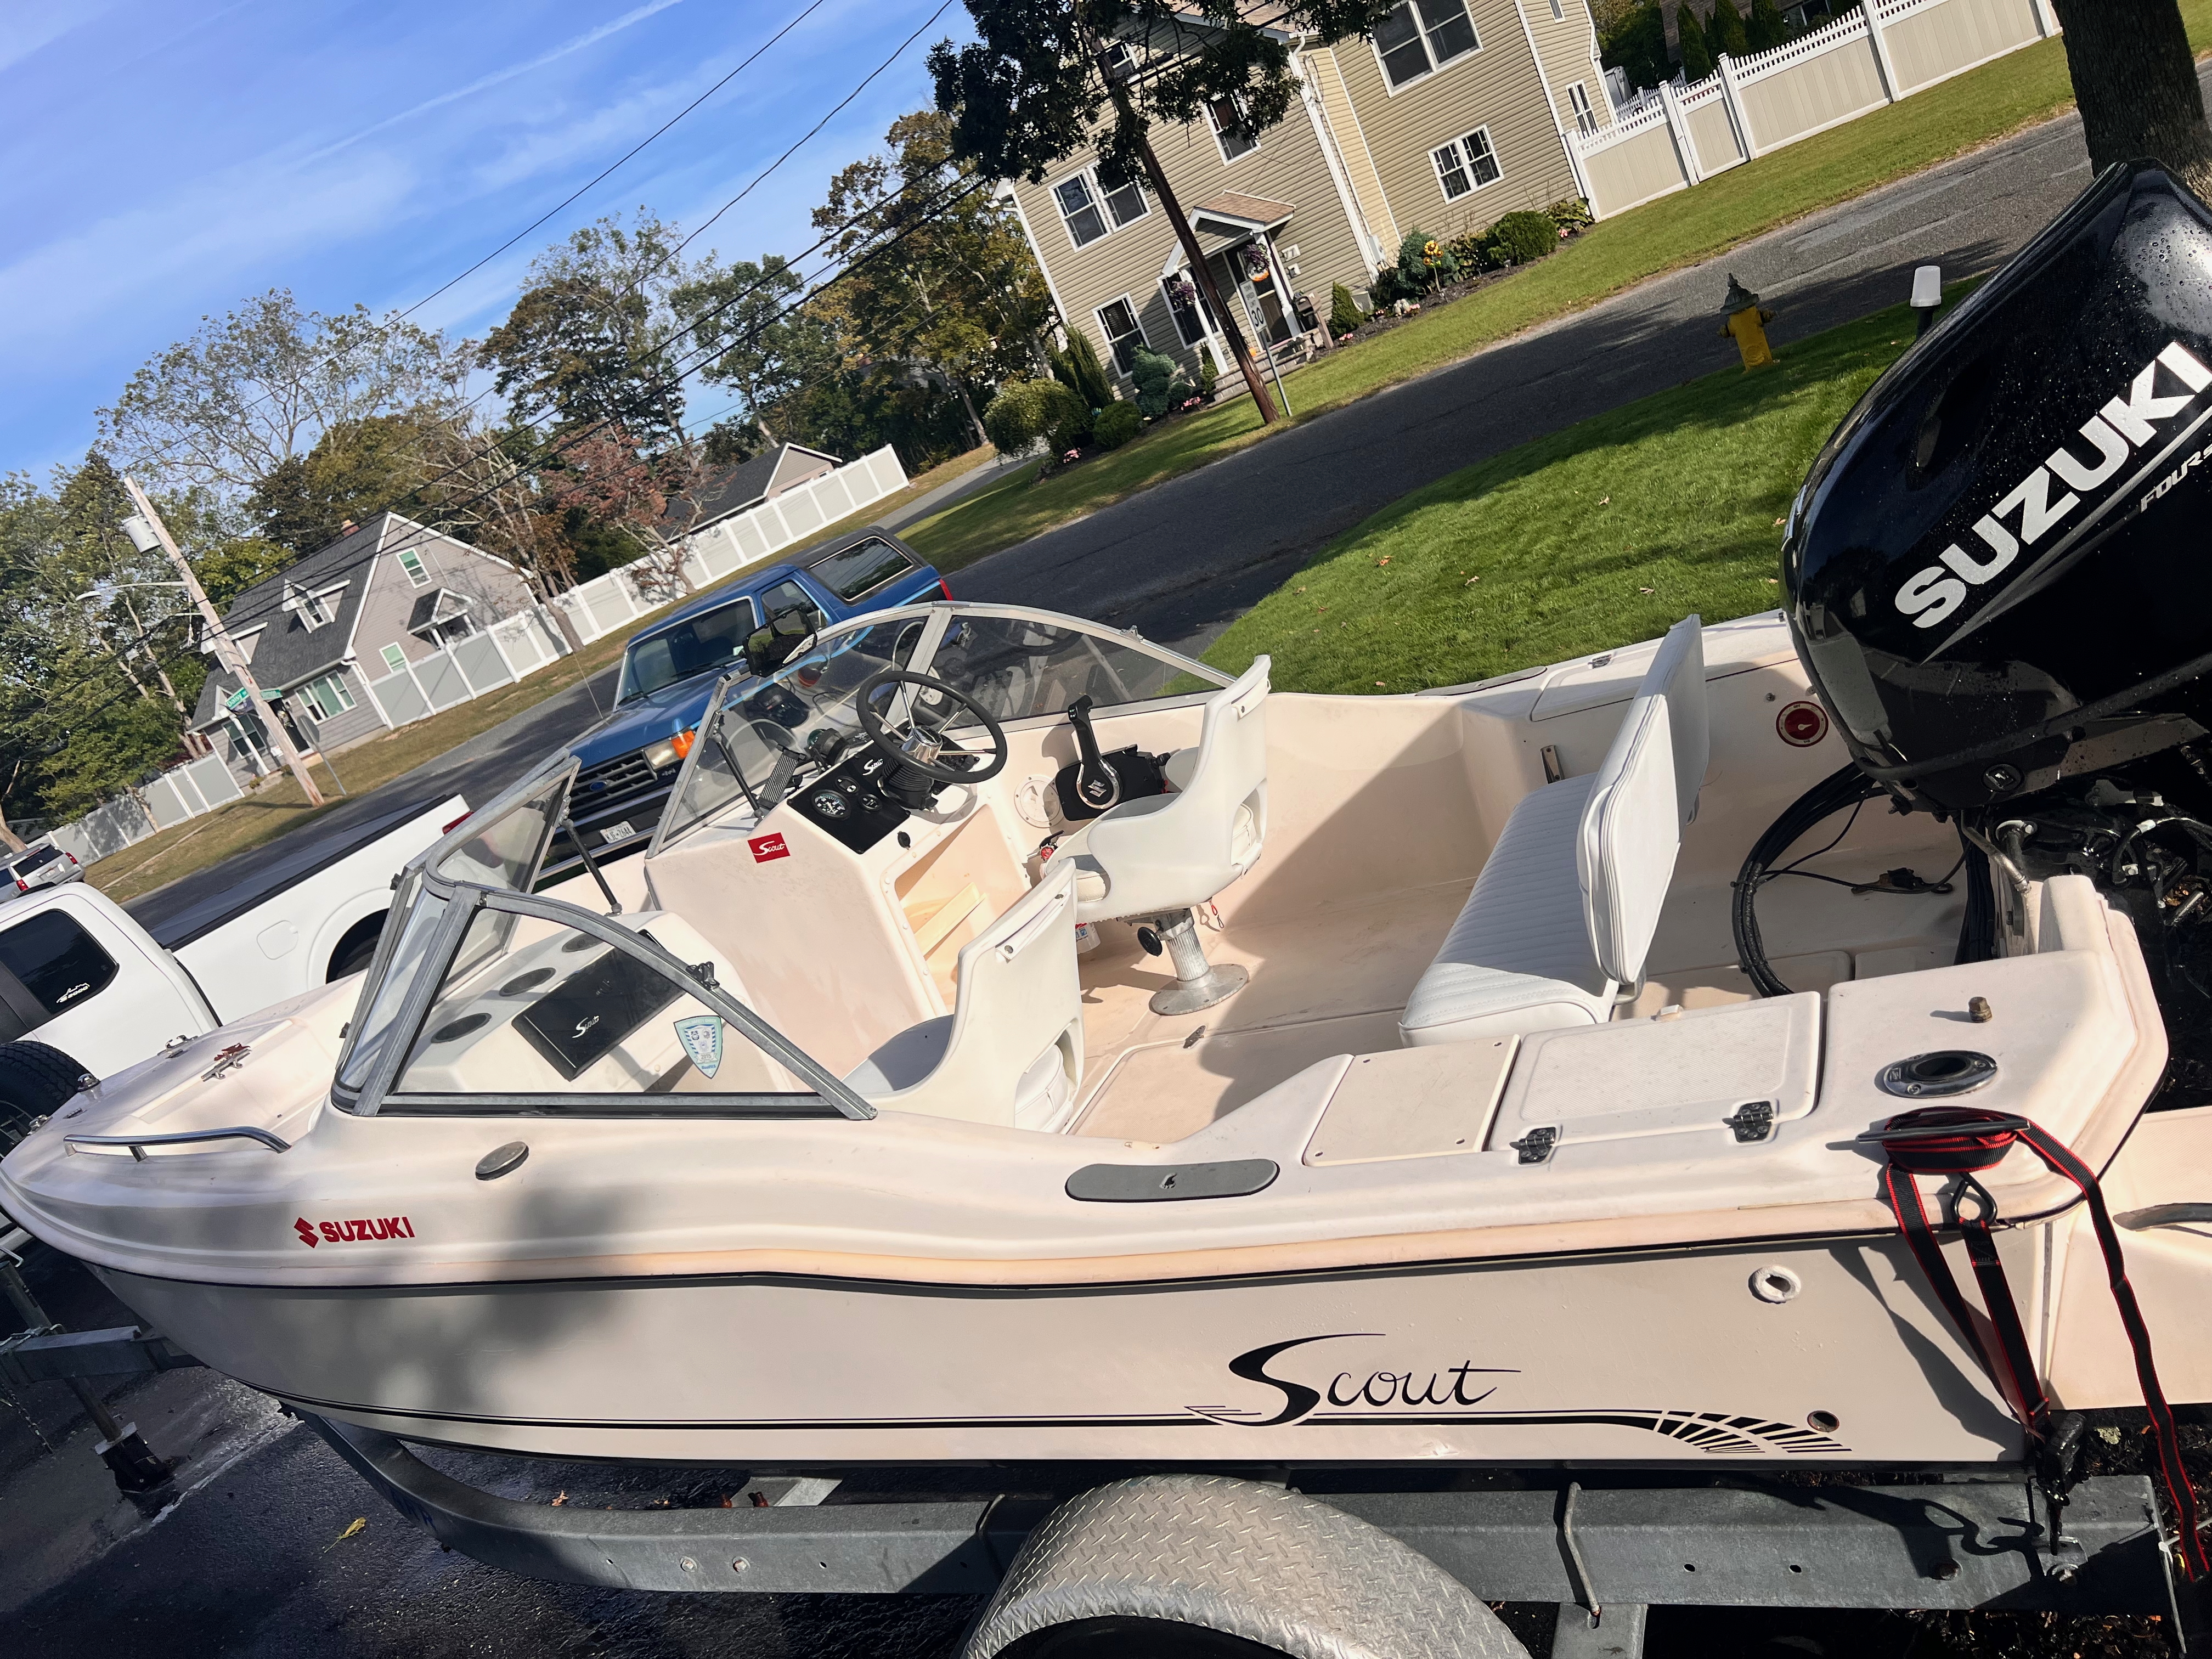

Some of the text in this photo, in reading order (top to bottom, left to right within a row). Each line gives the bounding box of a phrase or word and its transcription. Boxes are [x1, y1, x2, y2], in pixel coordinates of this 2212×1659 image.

[1251, 307, 1263, 327] 30
[1894, 341, 2212, 628] SUZUKI
[227, 692, 242, 708] Daisy
[862, 758, 883, 776] Scout
[753, 840, 785, 856] Scout
[572, 1015, 600, 1039] Scout
[319, 1216, 415, 1242] SUZUKI
[1184, 1333, 1521, 1426] Scout
